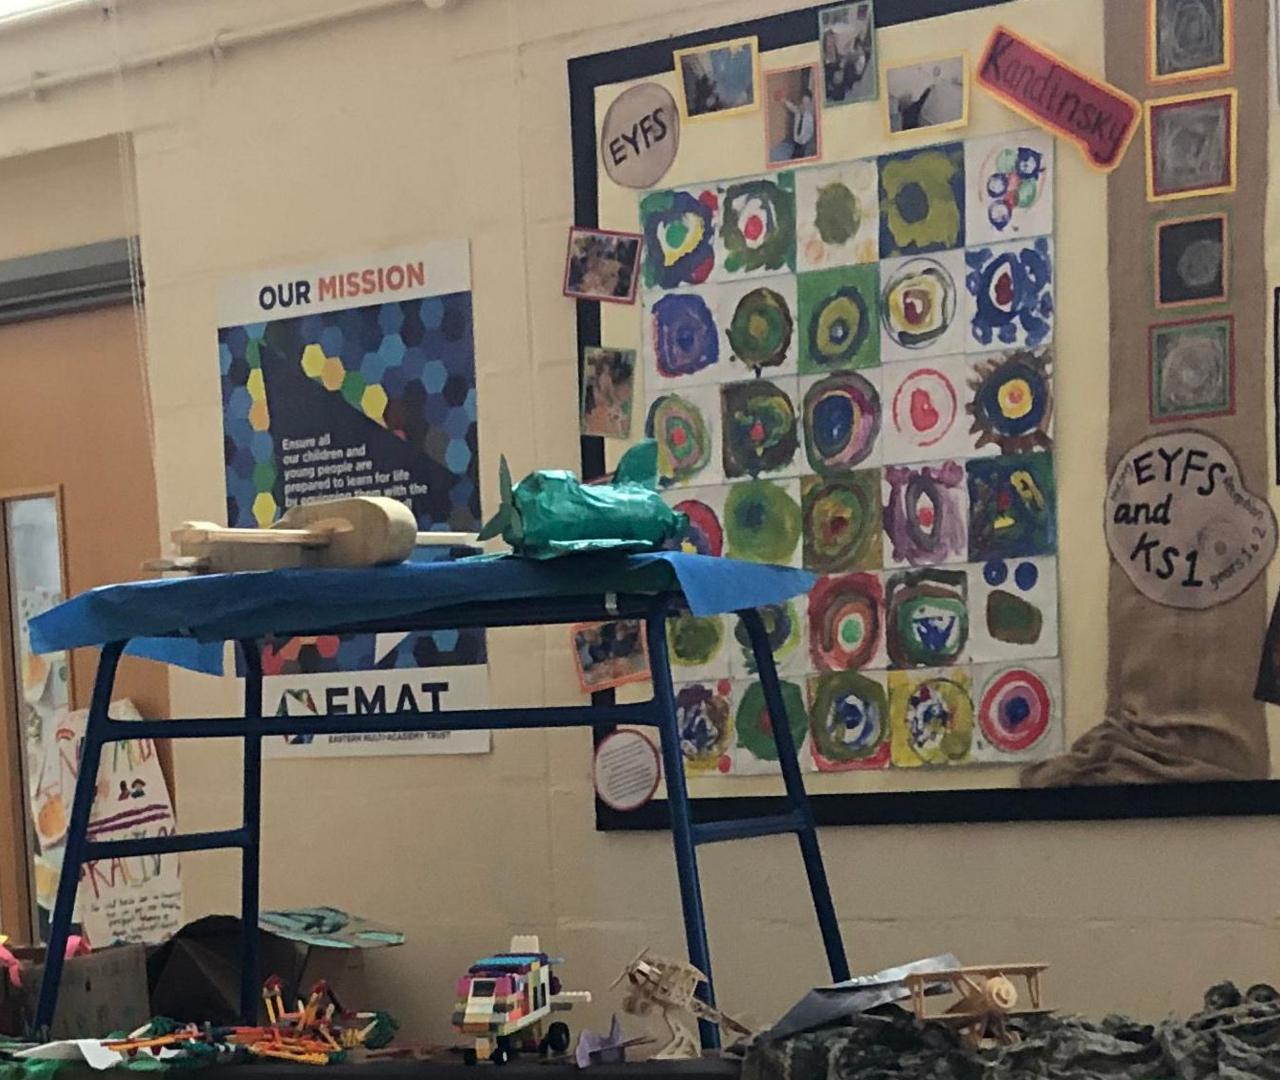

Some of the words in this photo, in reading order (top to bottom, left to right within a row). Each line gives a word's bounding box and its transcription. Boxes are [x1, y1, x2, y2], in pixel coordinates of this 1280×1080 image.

[609, 107, 667, 167] EYFS
[258, 280, 311, 311] OUR
[317, 261, 426, 302] MISSION
[282, 437, 316, 451] Ensure
[318, 433, 331, 447] all
[283, 454, 300, 465] our
[302, 447, 344, 463] children
[346, 444, 366, 458] and
[284, 467, 315, 482] young
[317, 463, 354, 478] people
[355, 459, 373, 471] are
[284, 480, 331, 495] prepared
[333, 475, 345, 488] to
[346, 473, 373, 487] learn
[374, 470, 391, 484] for
[392, 469, 410, 483] life
[1133, 447, 1227, 496] EYFS
[409, 482, 429, 495] the
[1114, 493, 1173, 525] and
[1130, 531, 1204, 588] KS1
